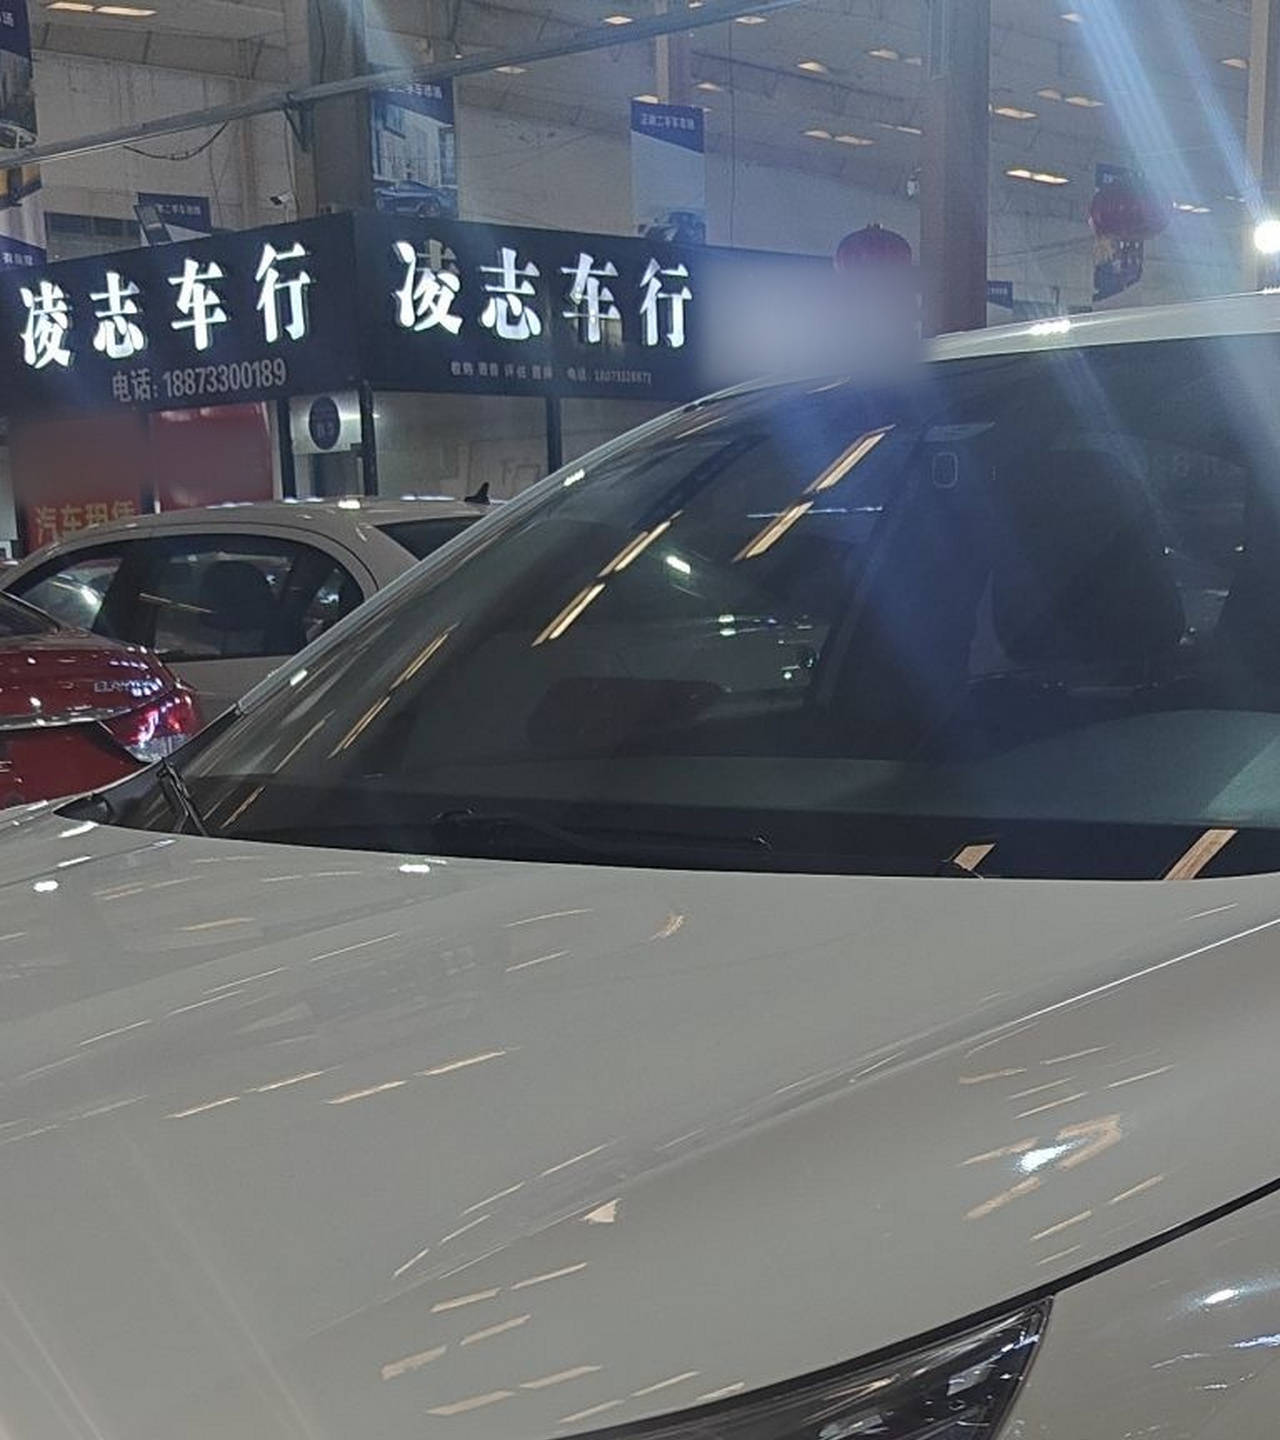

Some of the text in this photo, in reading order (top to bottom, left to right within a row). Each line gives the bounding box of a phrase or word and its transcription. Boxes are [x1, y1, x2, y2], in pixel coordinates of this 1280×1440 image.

[19, 242, 312, 369] 凌志车行
[392, 239, 694, 349] 凌志车行
